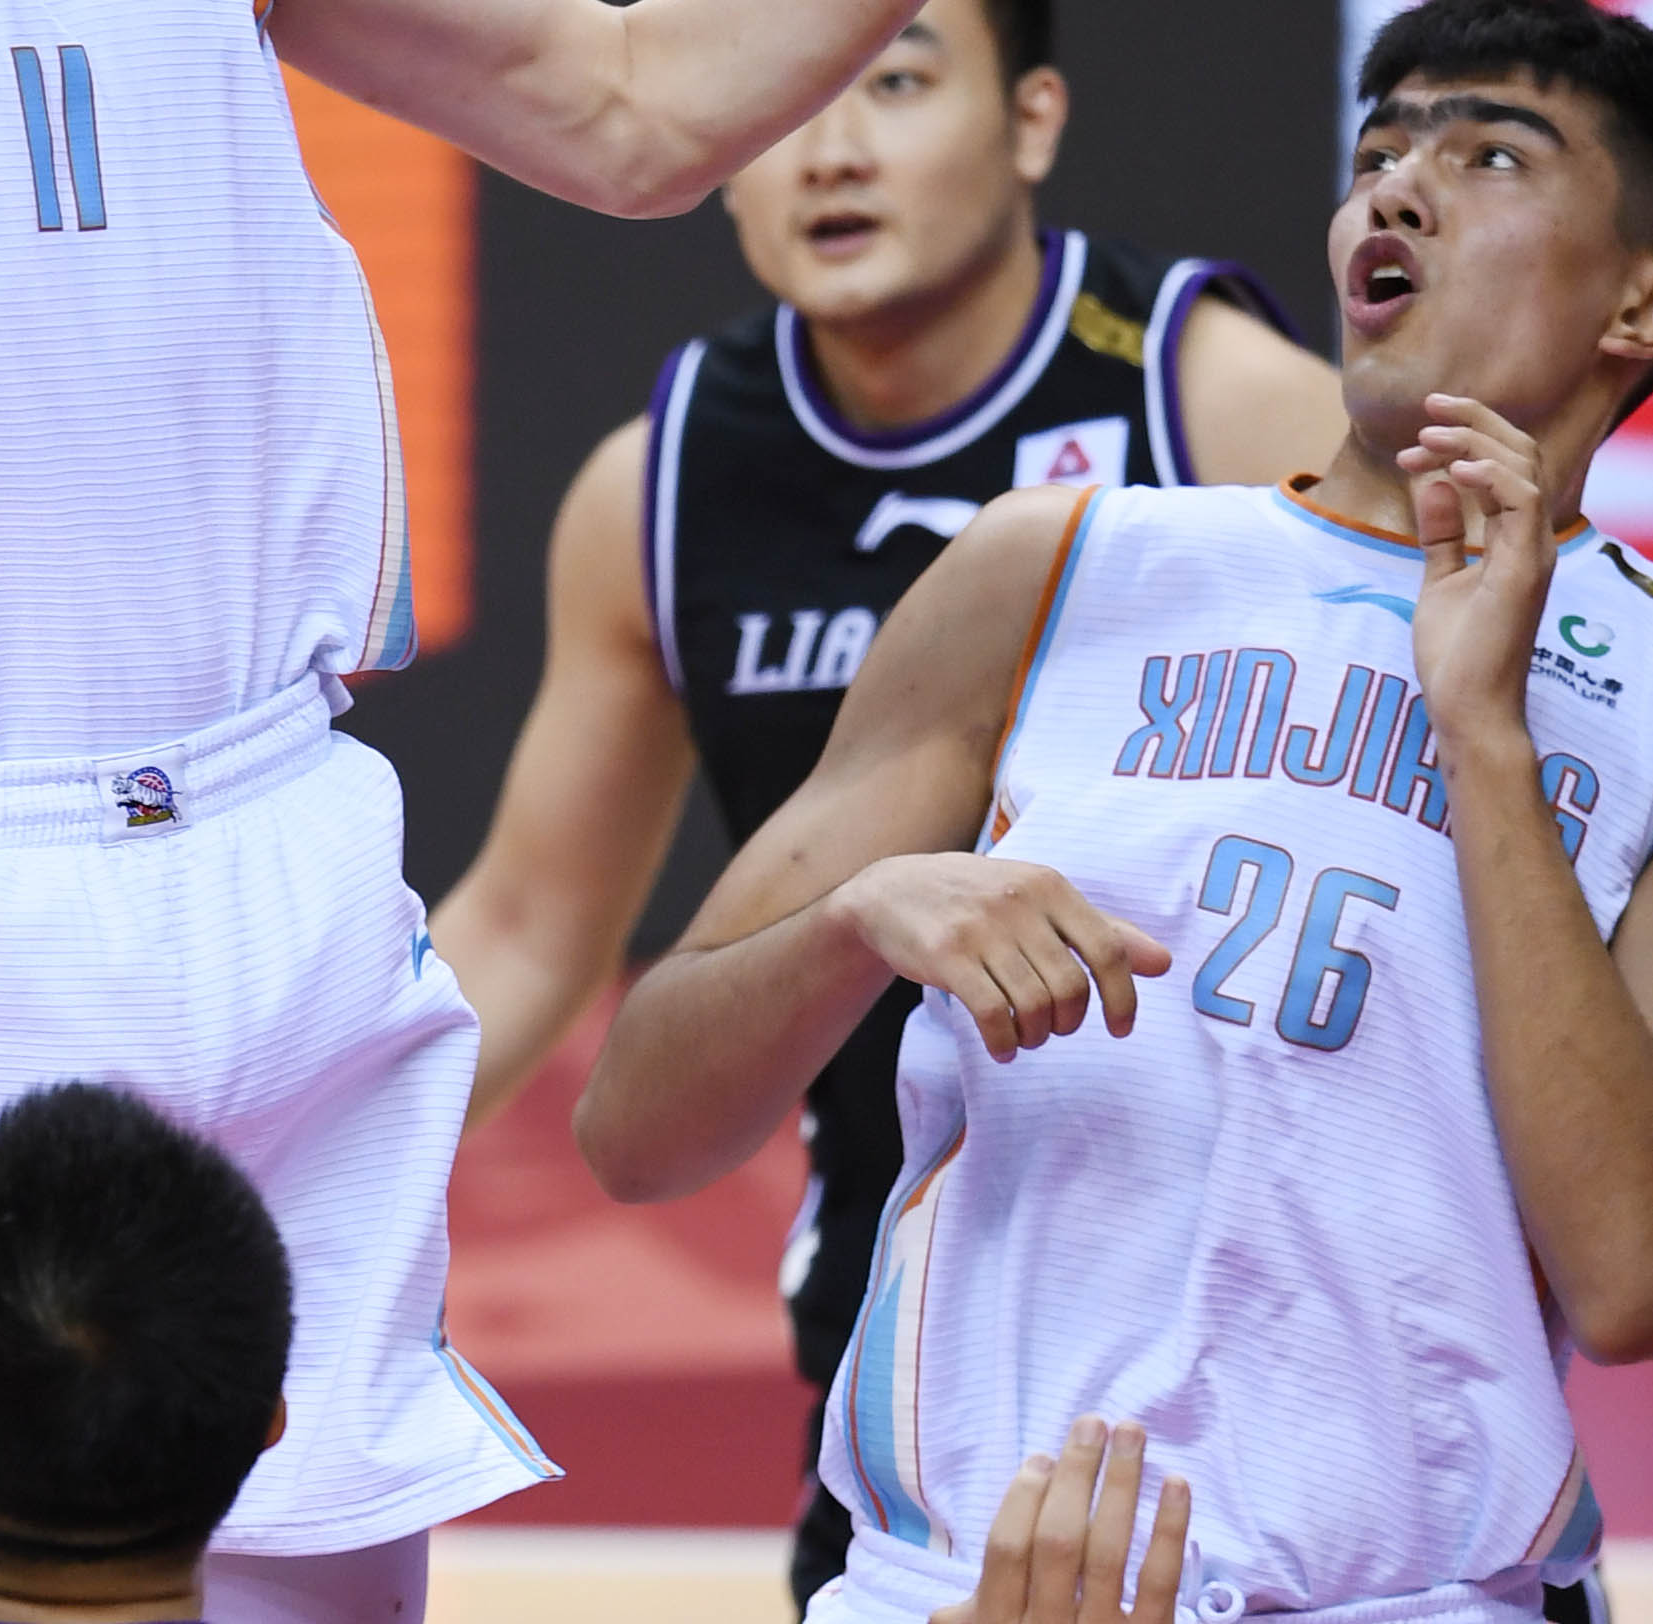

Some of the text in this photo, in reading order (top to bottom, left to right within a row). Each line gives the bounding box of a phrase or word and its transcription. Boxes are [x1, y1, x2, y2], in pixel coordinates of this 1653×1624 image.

[11, 44, 107, 232] 11
[1113, 648, 1599, 867] XINJIAG
[1191, 834, 1400, 1053] 26
